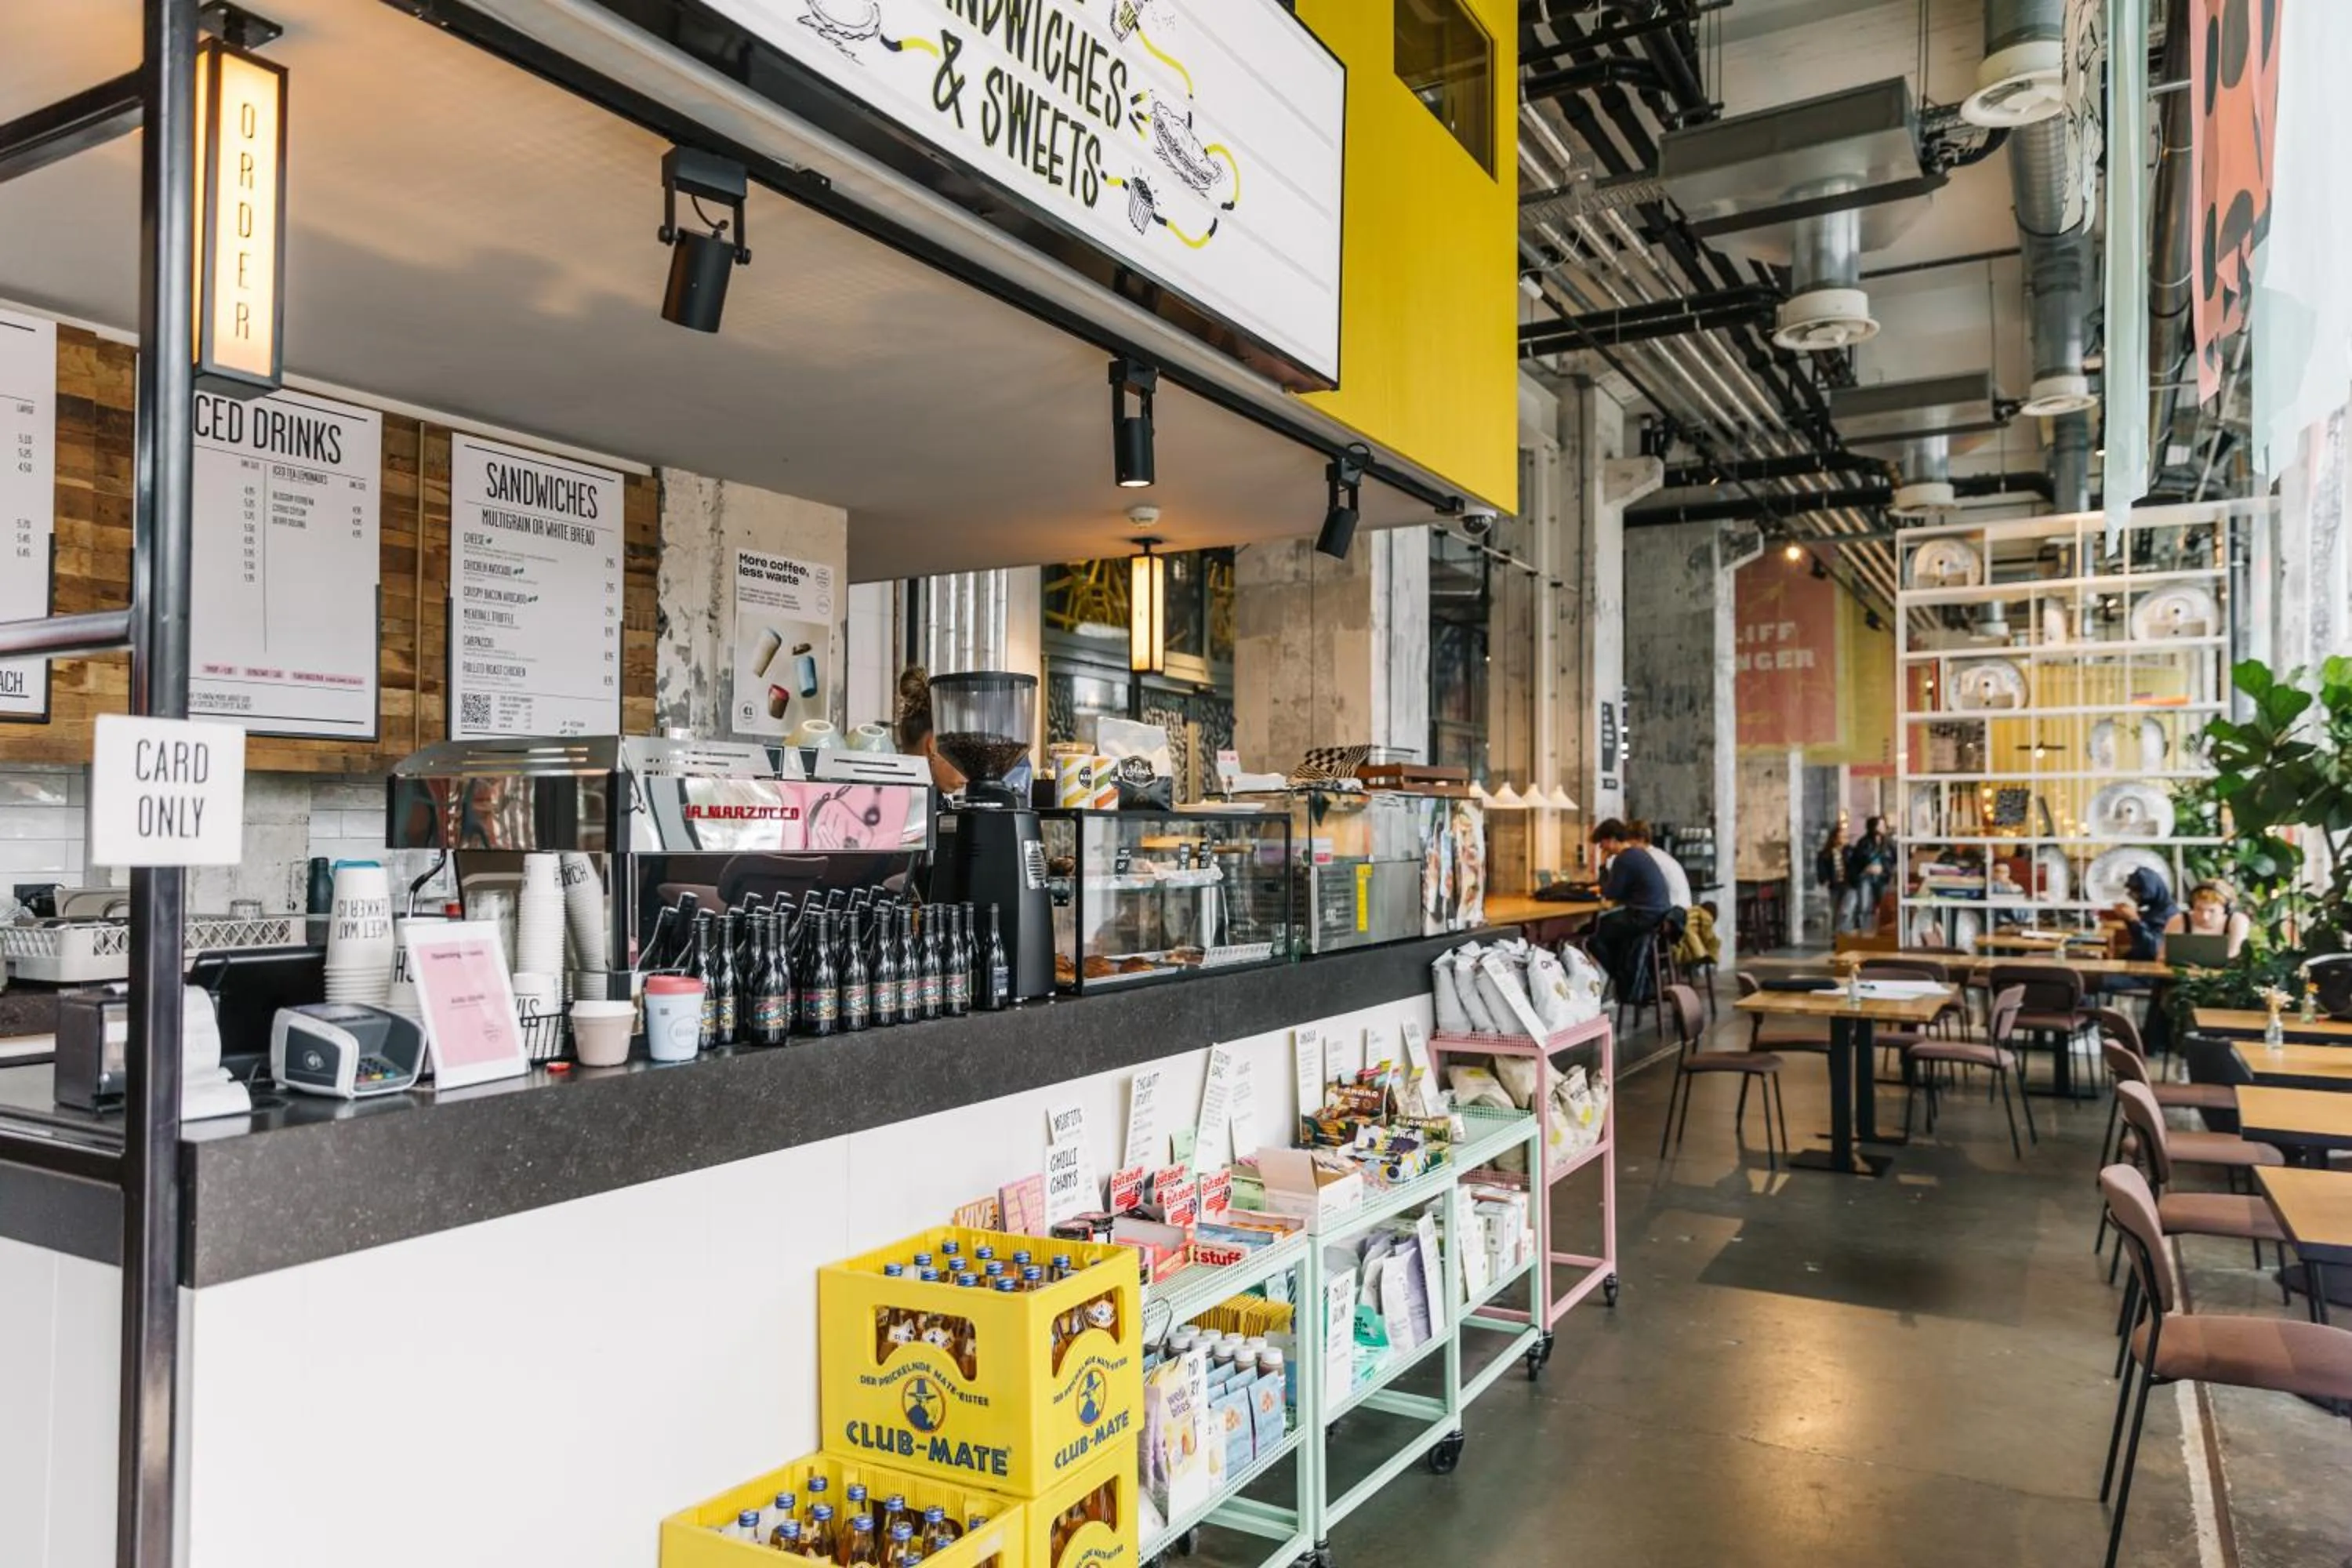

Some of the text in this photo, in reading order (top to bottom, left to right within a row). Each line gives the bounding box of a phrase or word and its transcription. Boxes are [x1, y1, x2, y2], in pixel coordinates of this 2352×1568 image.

[931, 29, 1102, 209] & SWEETS
[236, 103, 256, 339] ORDER
[194, 394, 343, 465] CED DRINKS
[486, 462, 597, 520] SANDWICHES
[482, 508, 595, 546] MULTIGRAIN OR WHITE BREAD
[739, 553, 810, 578] More coffee,
[739, 564, 764, 579] less
[765, 571, 800, 586] waste
[1737, 622, 1795, 644] IFF
[135, 739, 209, 784] CARD
[138, 794, 205, 838] ONLY
[1126, 1166, 1144, 1184] stuff
[1167, 1165, 1185, 1181] stuff
[1214, 1171, 1231, 1187] stuff
[1178, 1183, 1196, 1200] stuff
[1200, 1250, 1242, 1266] stuff
[860, 1374, 877, 1386] DER
[878, 1361, 931, 1387] PRICKELNDE
[846, 1420, 1008, 1476] CLUB-MATE
[1053, 1410, 1130, 1468] CLUB-MATE
